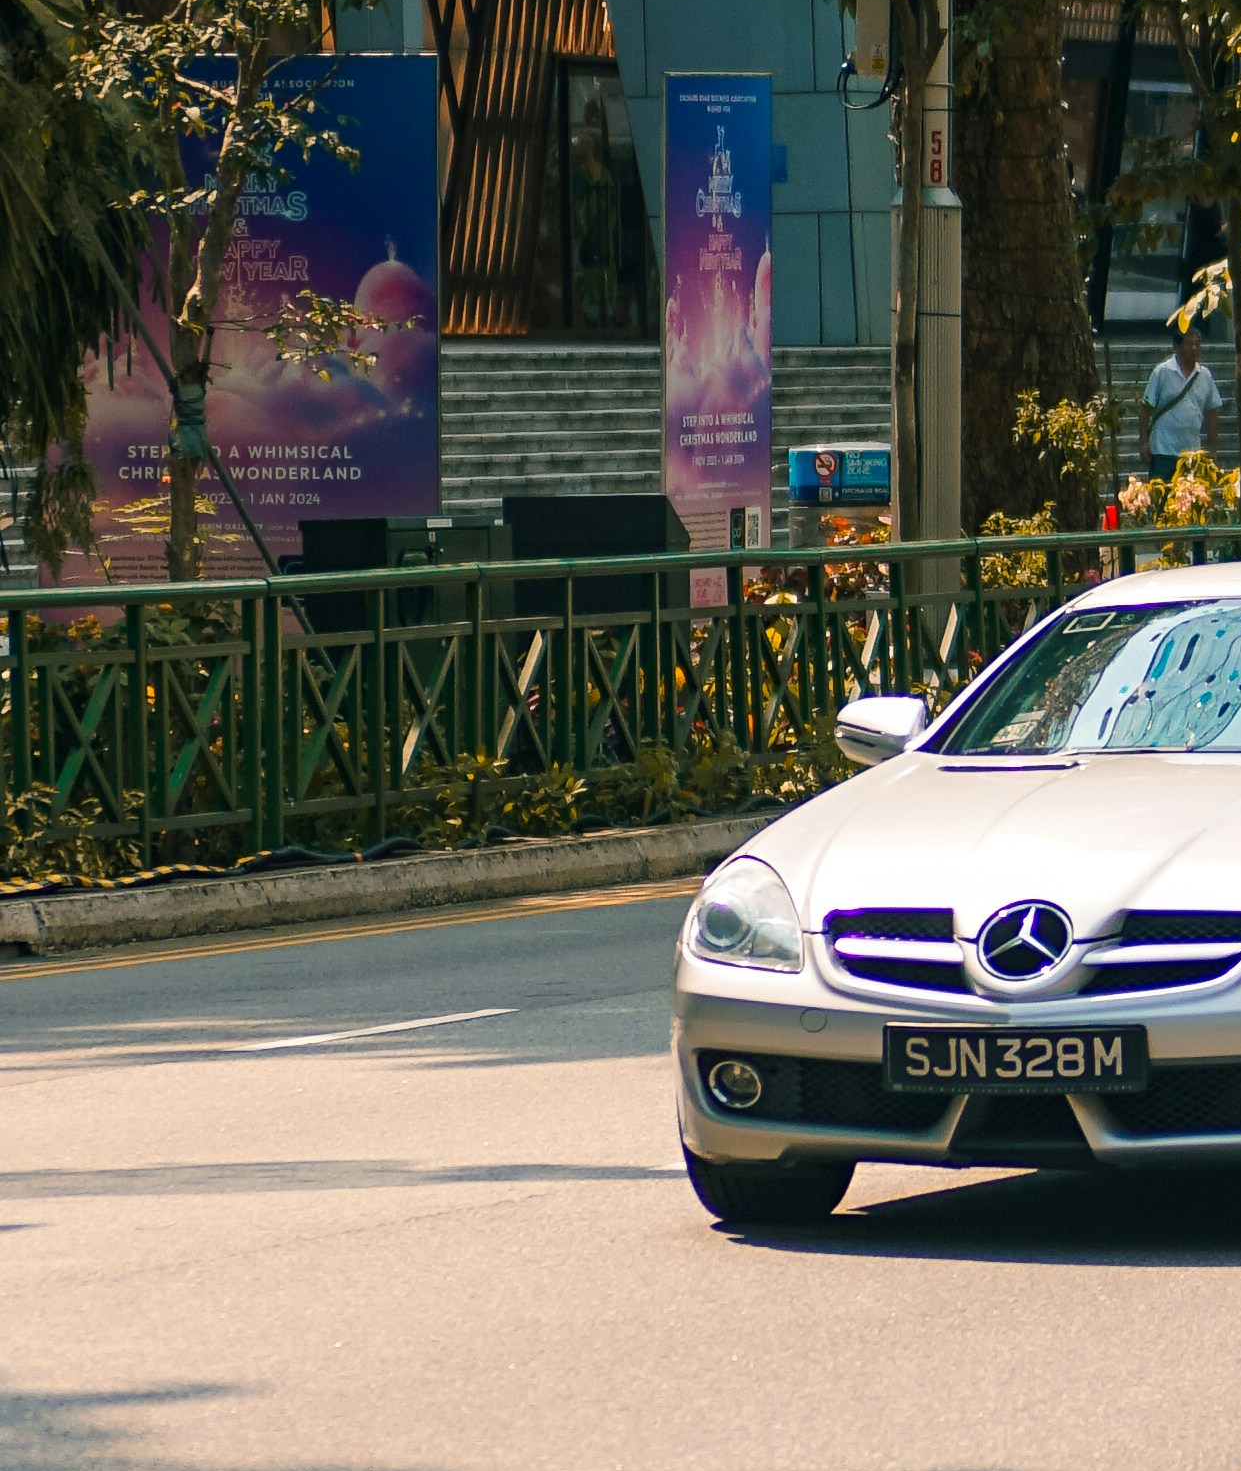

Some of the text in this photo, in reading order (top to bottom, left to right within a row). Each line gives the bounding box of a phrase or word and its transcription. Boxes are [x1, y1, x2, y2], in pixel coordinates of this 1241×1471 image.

[232, 218, 249, 237] &
[223, 239, 281, 259] APPY
[244, 255, 310, 281] YEAR
[228, 445, 241, 459] A
[247, 445, 353, 460] WHIMSICAL
[230, 466, 362, 480] WONDERLAND
[259, 492, 285, 505] JAN
[289, 492, 321, 505] 2024
